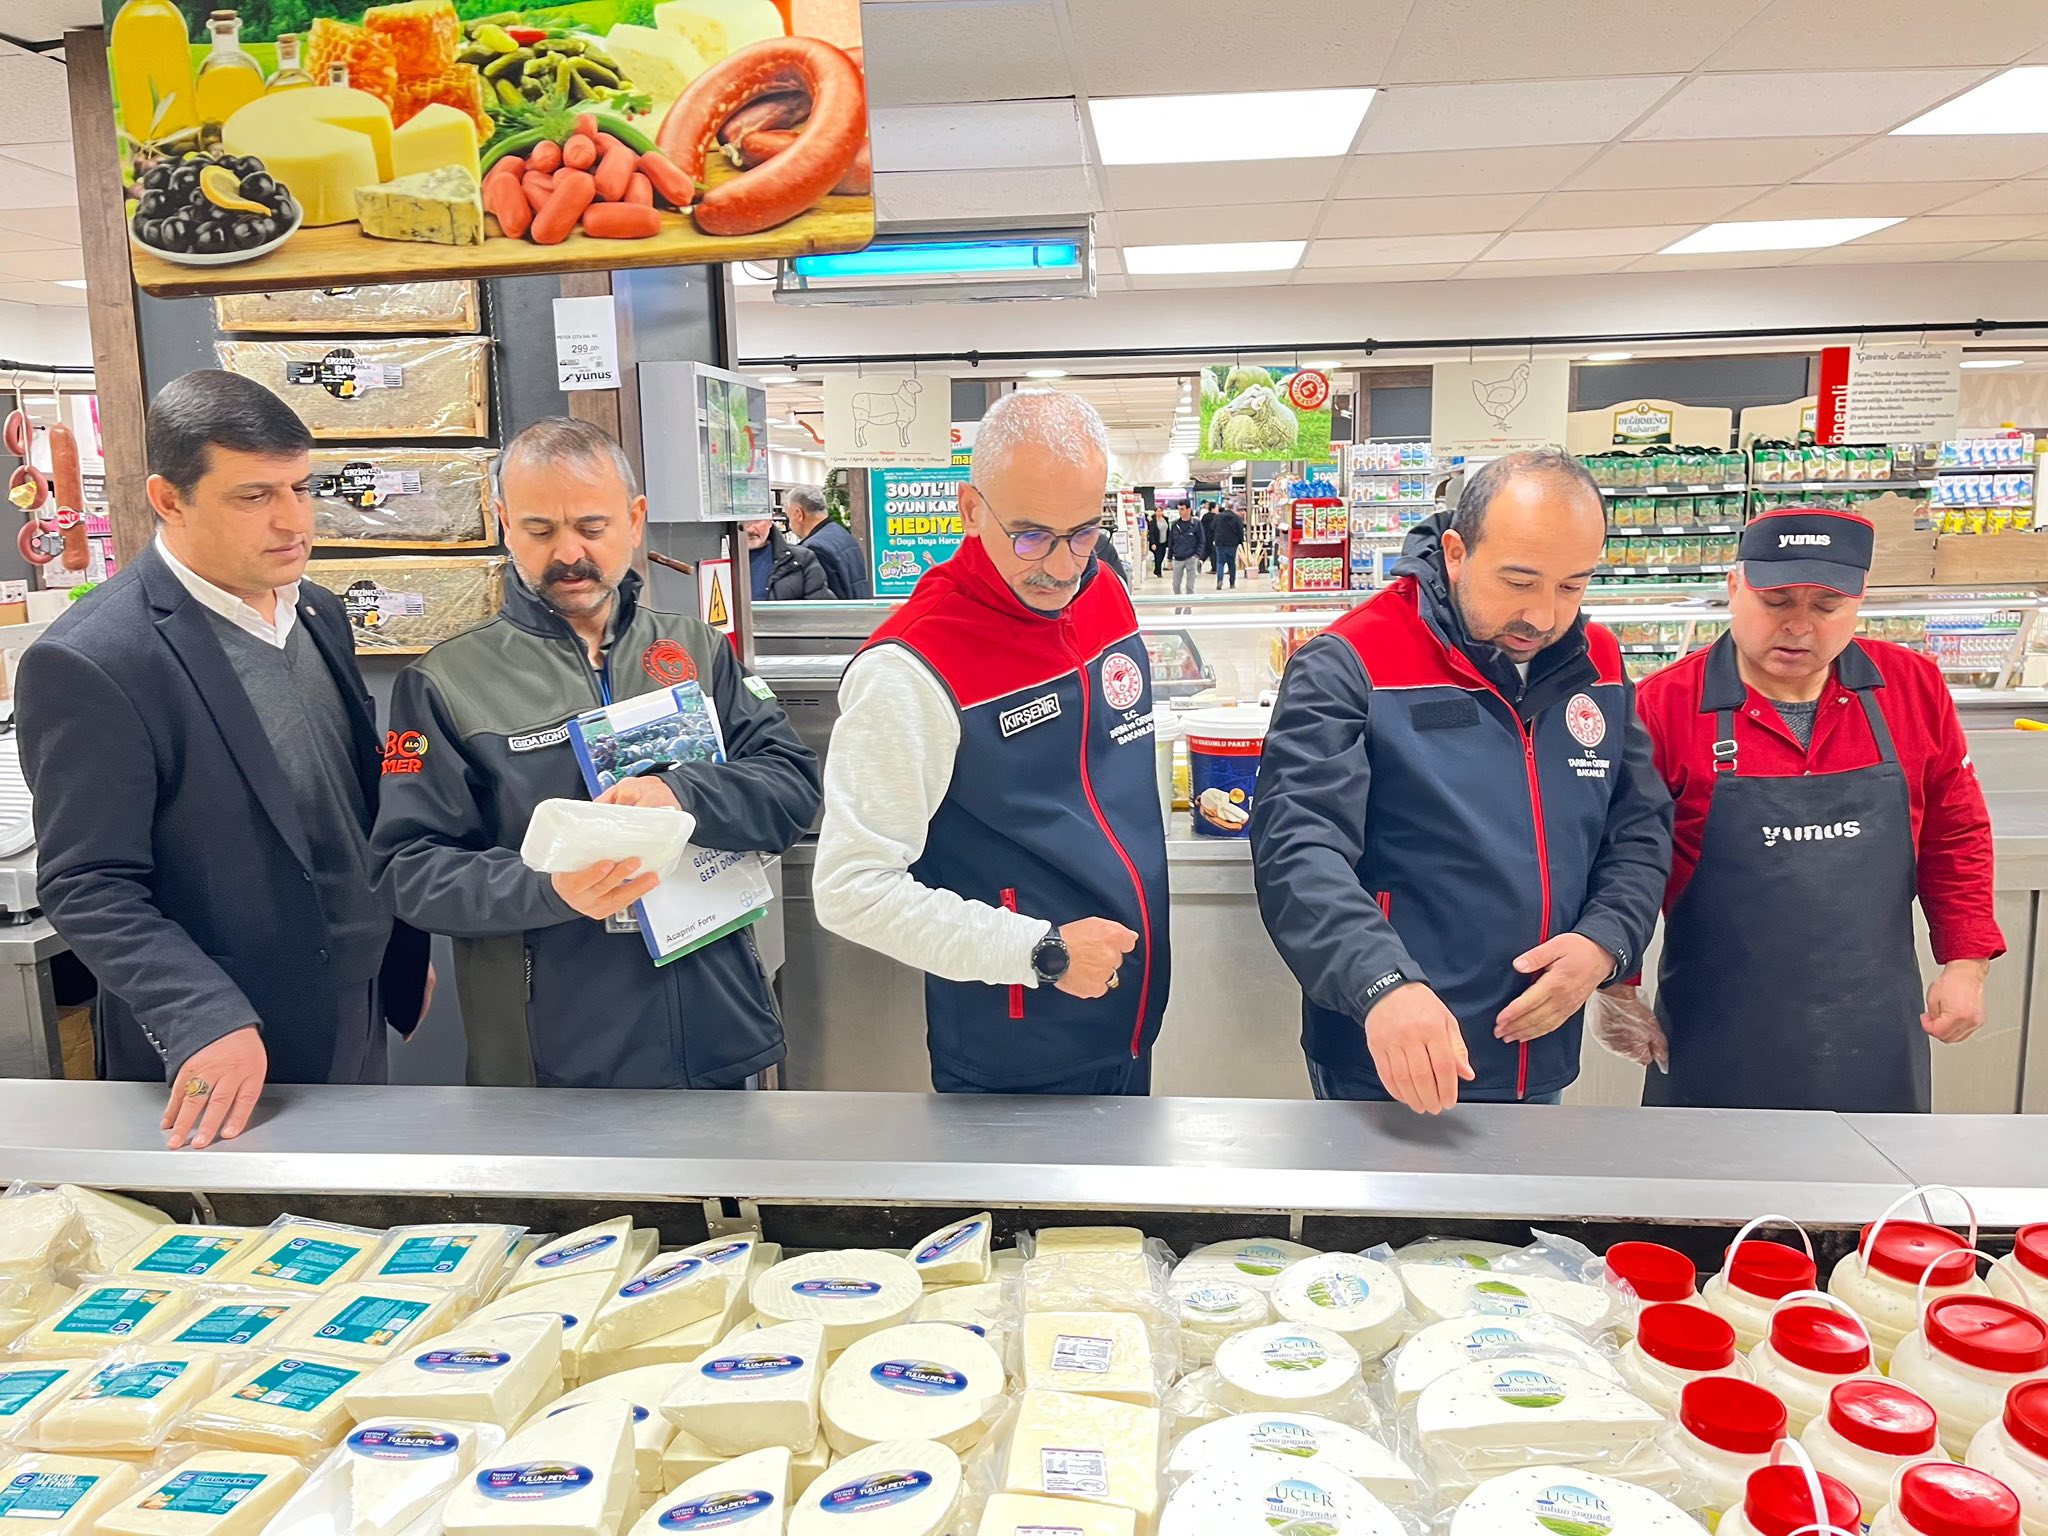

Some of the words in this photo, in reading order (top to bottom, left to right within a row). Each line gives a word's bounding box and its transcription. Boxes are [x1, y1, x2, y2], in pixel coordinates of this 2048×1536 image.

[575, 371, 611, 382] yunus
[1828, 384, 1848, 444] önemli
[886, 482, 959, 498] 300TL'li
[885, 501, 926, 514] OYUN
[1777, 533, 1831, 548] yunus
[1004, 699, 1058, 731] KIRŞEHİR
[513, 736, 540, 748] GIDA
[539, 728, 569, 744] KONT
[1762, 820, 1861, 846] yunus
[700, 862, 720, 882] GERİ
[698, 914, 717, 927] Forte
[387, 1436, 416, 1444] TULUM
[860, 1483, 888, 1495] TULUM
[699, 1504, 728, 1513] TULUM
